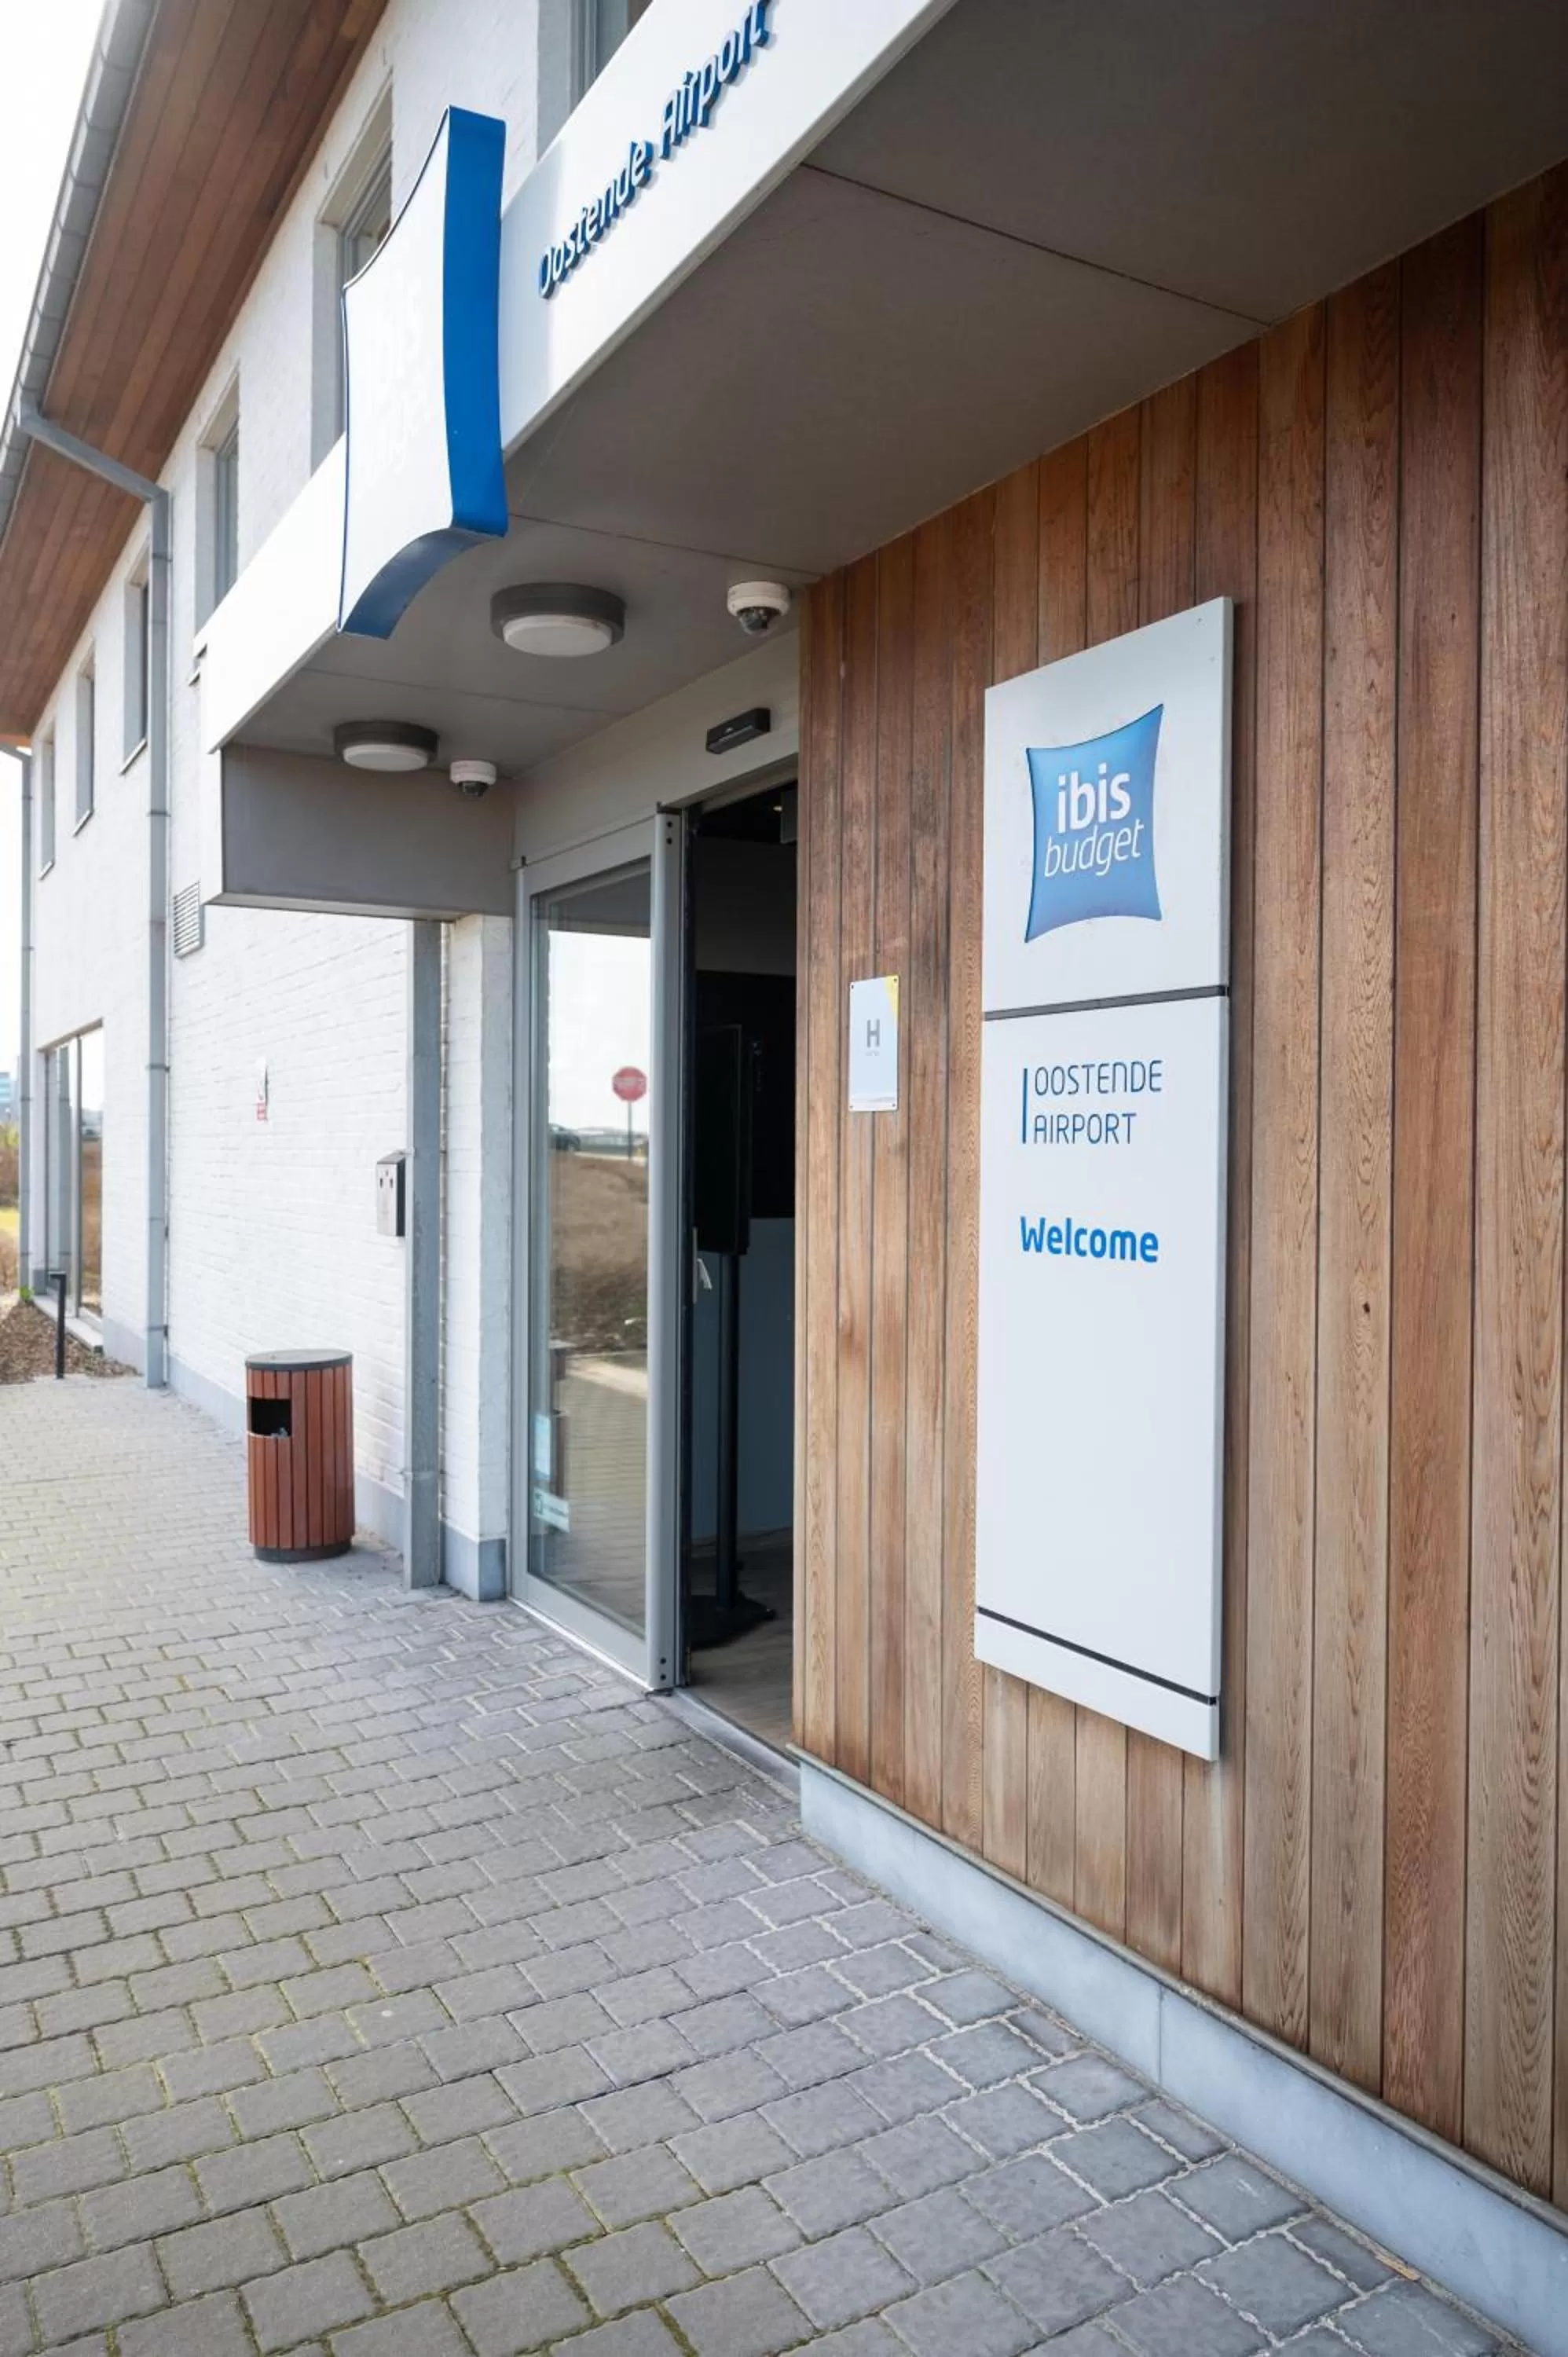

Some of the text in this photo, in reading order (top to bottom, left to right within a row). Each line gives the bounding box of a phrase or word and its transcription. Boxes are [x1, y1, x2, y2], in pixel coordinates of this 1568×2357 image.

[539, 141, 654, 299] Oostende
[1057, 763, 1131, 834] ibis
[1044, 819, 1144, 877] budget
[1035, 1060, 1163, 1096] OOSTENDE
[1034, 1113, 1137, 1144] AIRPORT
[1020, 1216, 1159, 1263] Welcome
